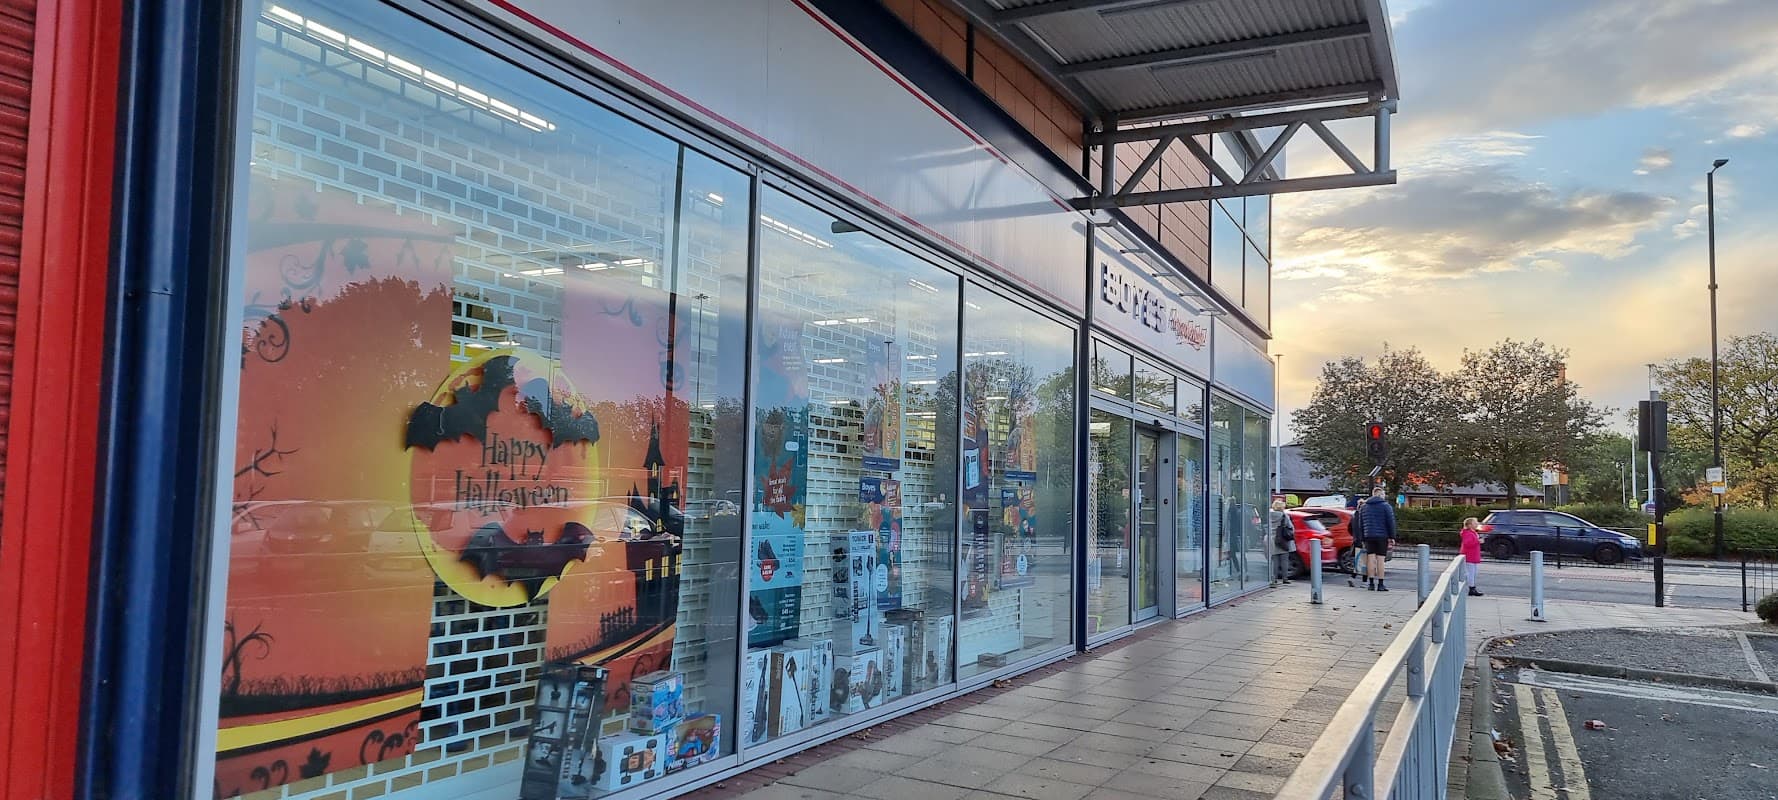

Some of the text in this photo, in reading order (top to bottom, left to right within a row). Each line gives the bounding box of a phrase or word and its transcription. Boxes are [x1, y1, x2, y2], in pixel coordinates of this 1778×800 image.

[1101, 262, 1167, 334] BOYES
[480, 431, 551, 481] Happy
[455, 469, 569, 516] Halloween
[861, 483, 876, 495] Boyes
